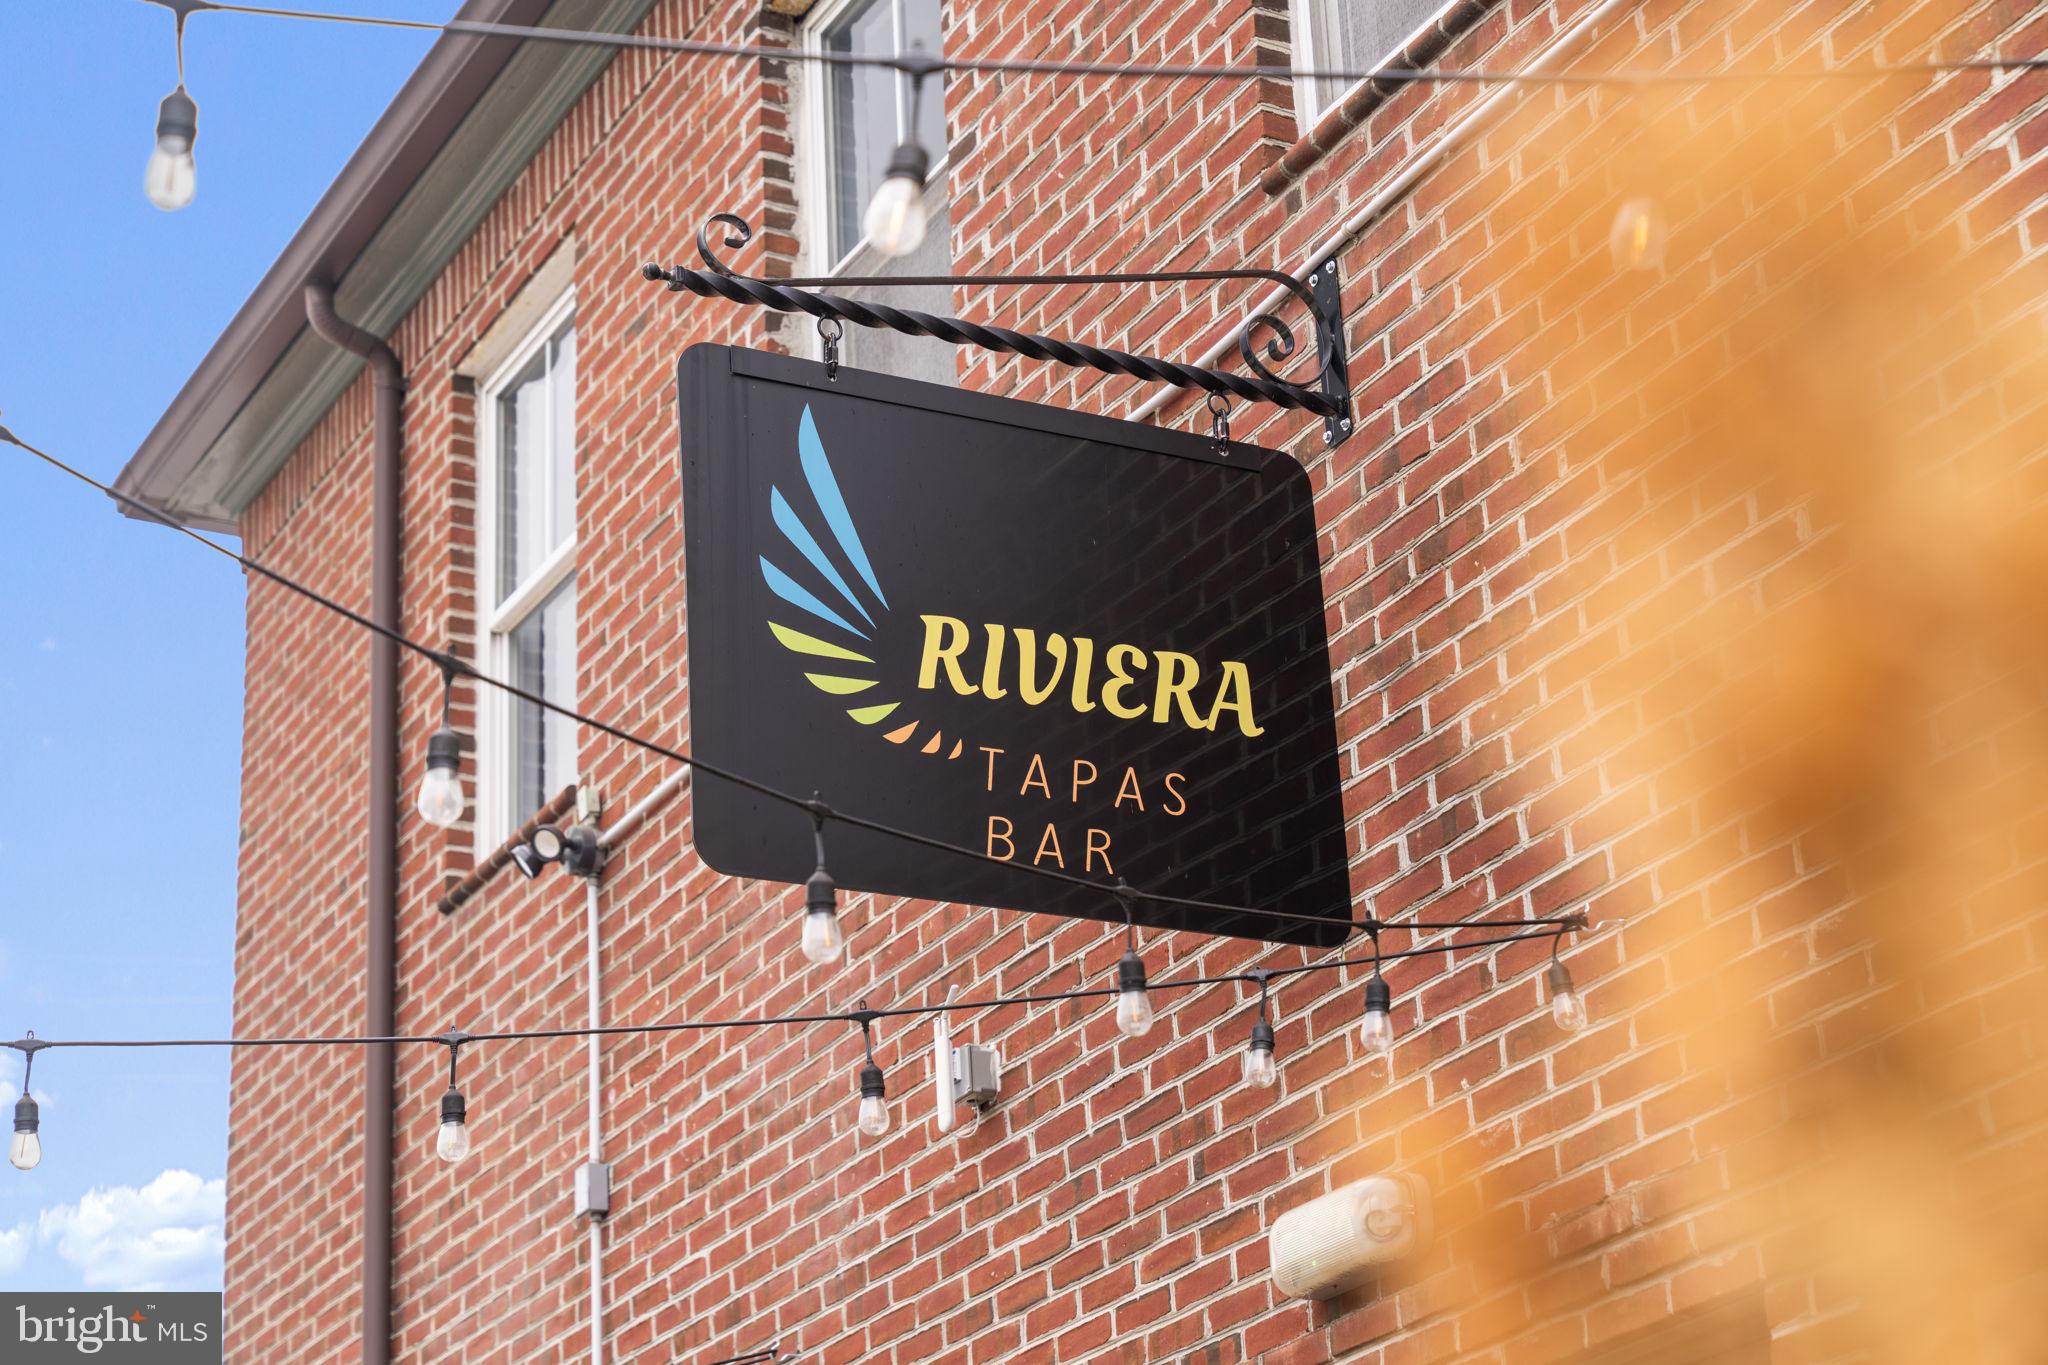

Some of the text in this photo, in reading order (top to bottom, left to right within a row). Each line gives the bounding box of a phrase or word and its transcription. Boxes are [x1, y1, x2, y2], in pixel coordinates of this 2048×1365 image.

[917, 614, 1265, 738] RIVIERA
[979, 746, 1187, 816] TAPAS
[986, 815, 1114, 875] BAR
